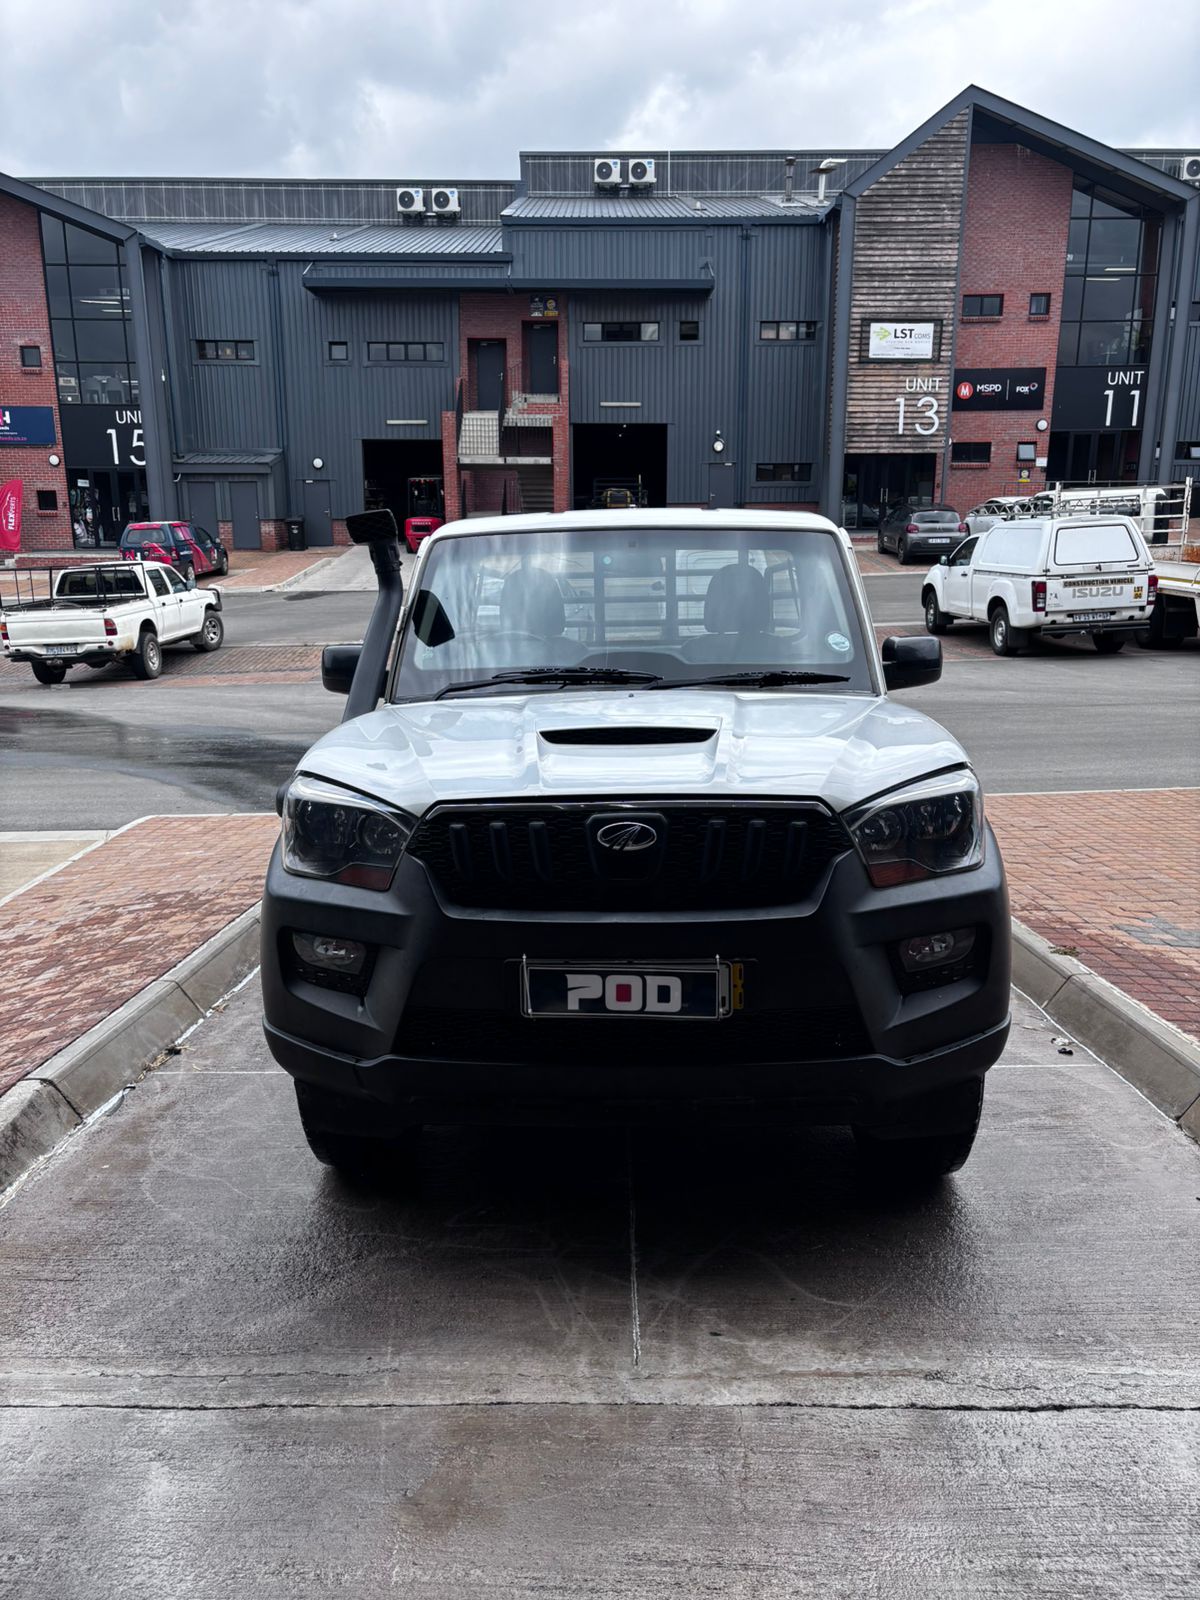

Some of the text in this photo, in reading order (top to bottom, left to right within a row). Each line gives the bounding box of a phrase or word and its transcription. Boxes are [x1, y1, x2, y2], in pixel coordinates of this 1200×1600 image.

[894, 328, 915, 339] LST
[905, 378, 942, 391] UNIT
[1107, 370, 1145, 385] UNIT
[976, 384, 1002, 392] MSPD
[895, 396, 940, 435] 13
[1104, 390, 1141, 427] 11
[115, 410, 142, 424] UNI
[106, 428, 146, 466] 15
[1063, 577, 1134, 587] CONSTRUCTION VEHICLE
[1072, 586, 1124, 598] ISUZU
[565, 974, 682, 1012] POD
